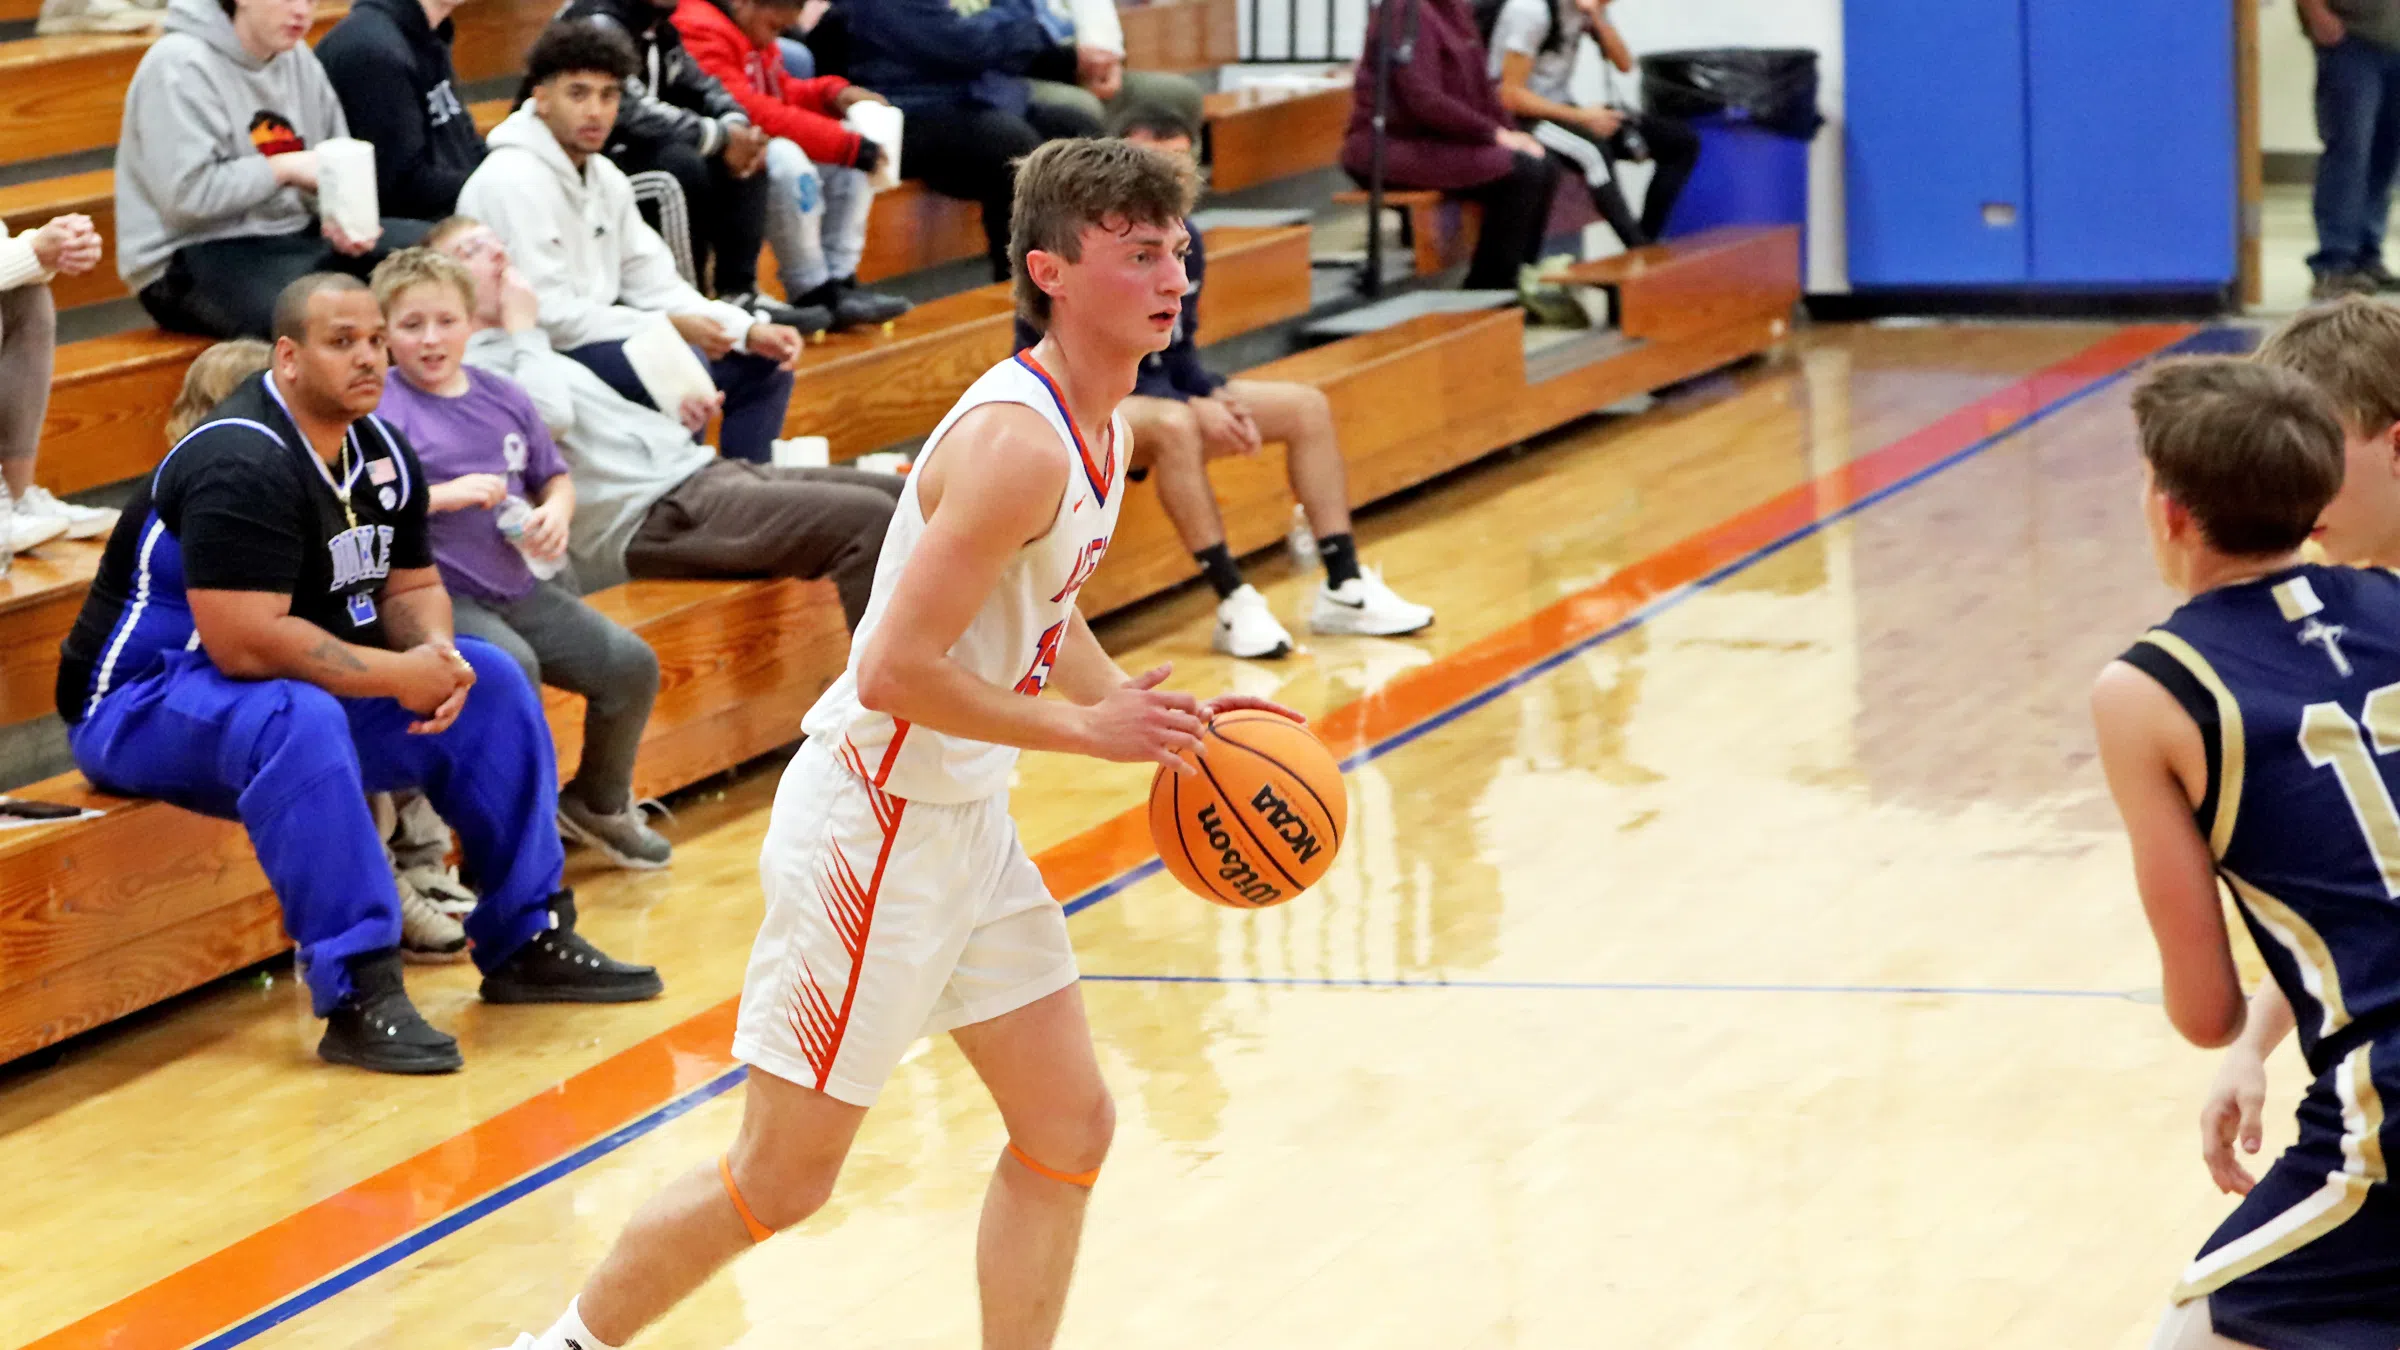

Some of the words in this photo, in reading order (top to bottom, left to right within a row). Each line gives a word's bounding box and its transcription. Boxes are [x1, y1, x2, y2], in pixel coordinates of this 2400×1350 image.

[1251, 784, 1322, 865] NCAA
[2297, 681, 2400, 900] 1
[1197, 801, 1281, 905] Wilson
